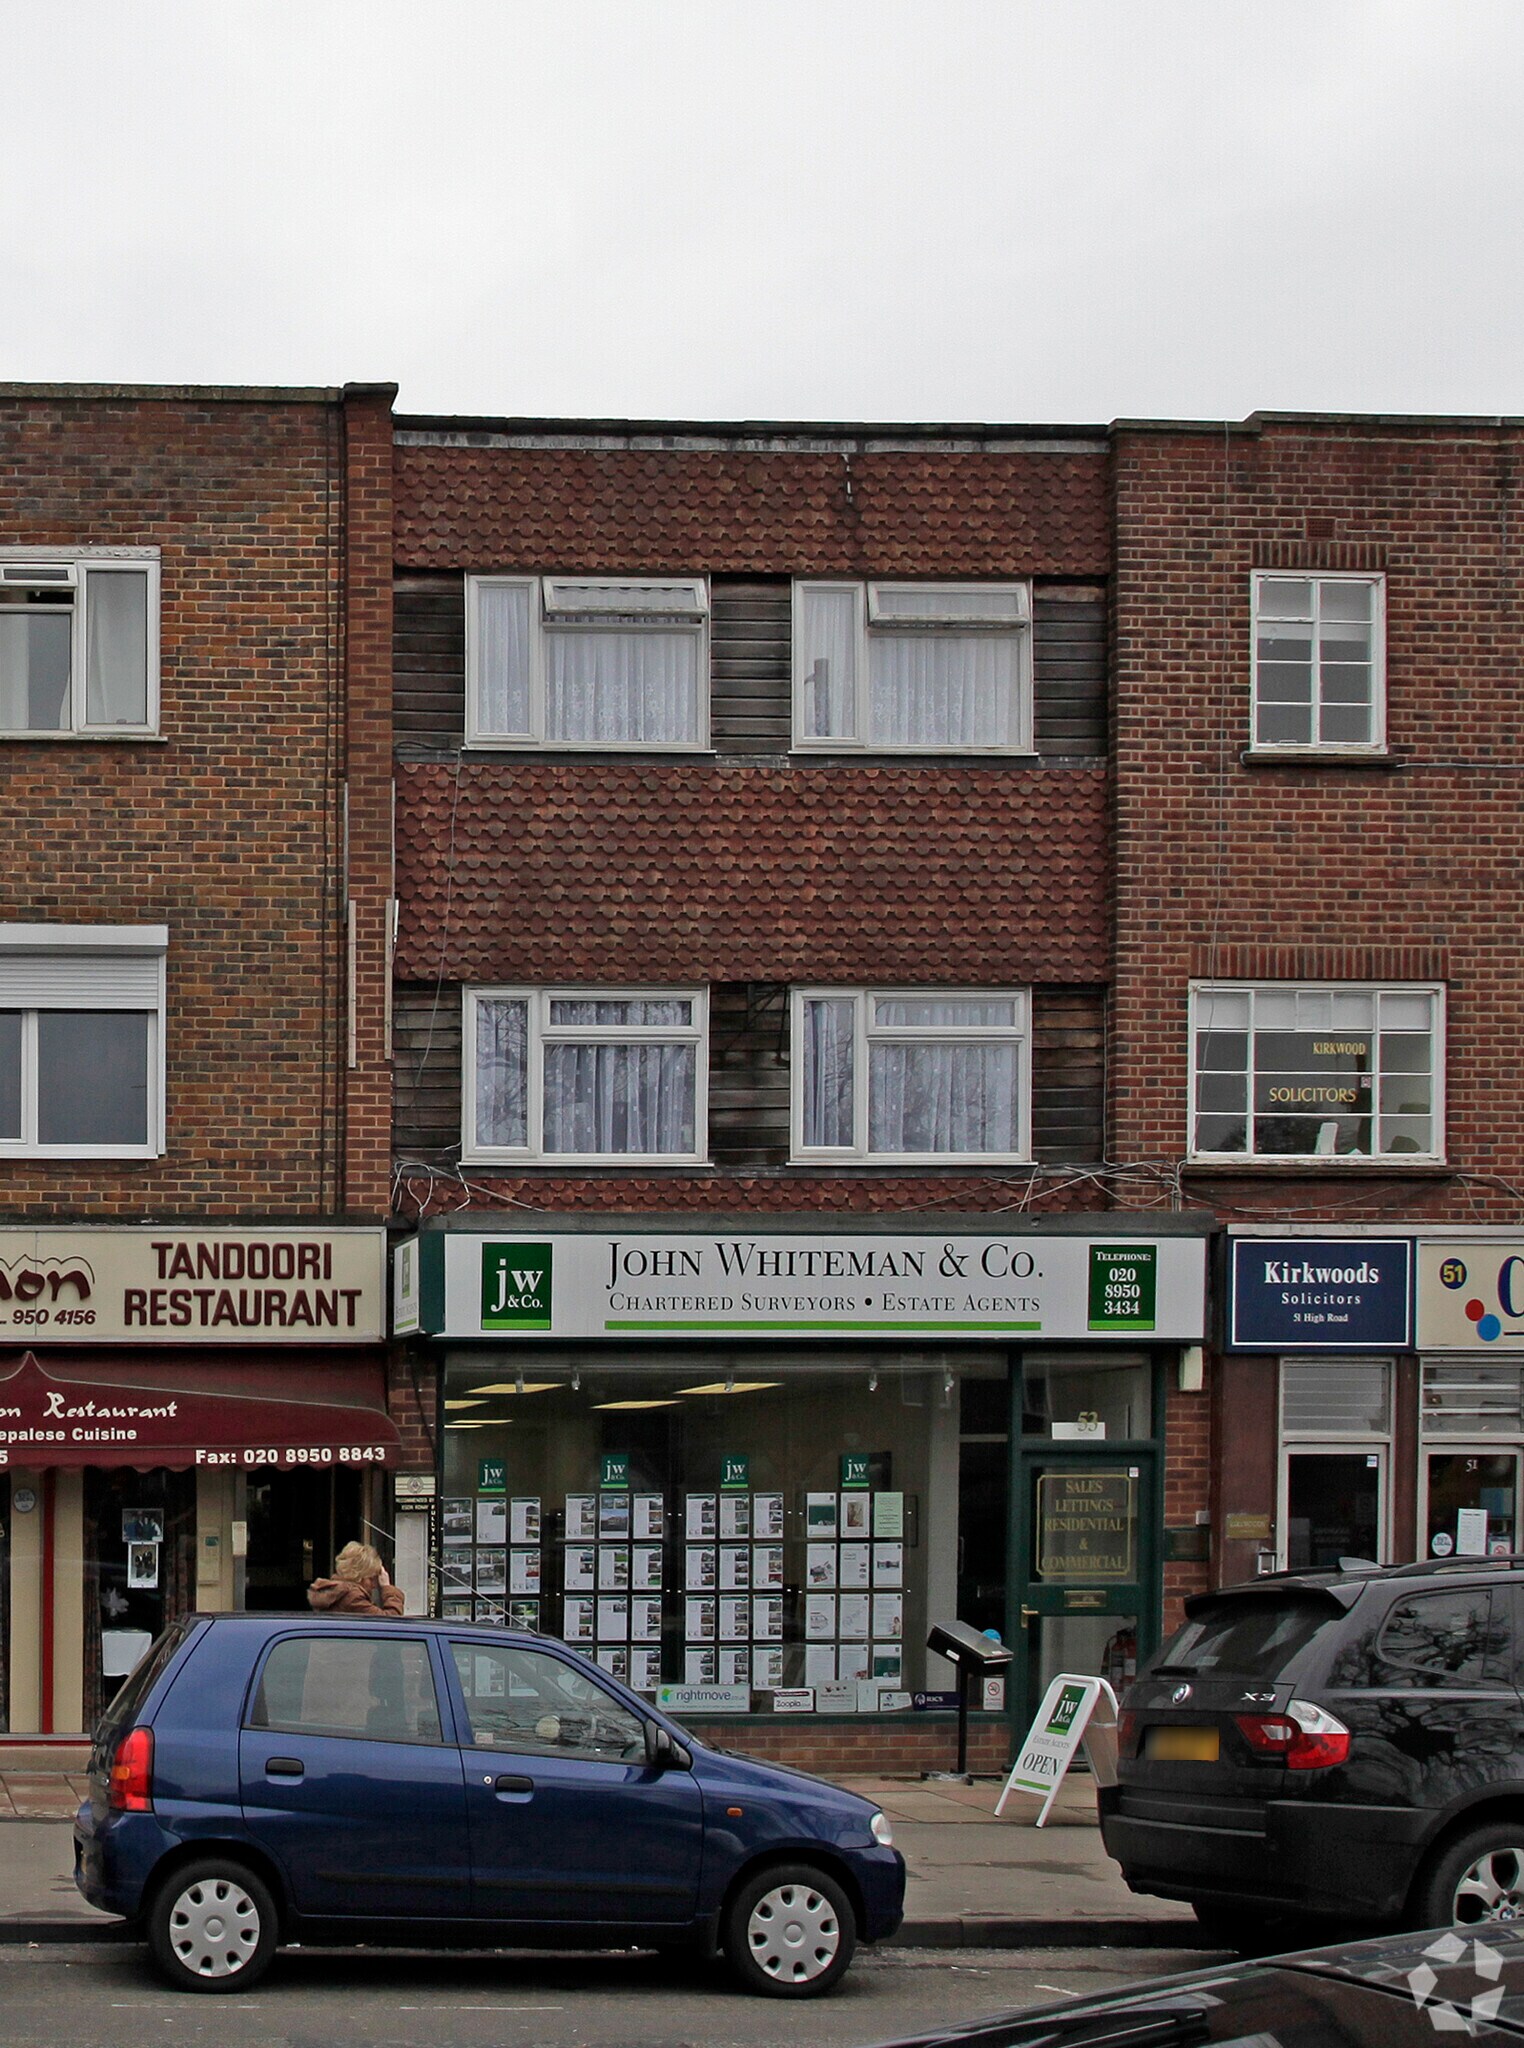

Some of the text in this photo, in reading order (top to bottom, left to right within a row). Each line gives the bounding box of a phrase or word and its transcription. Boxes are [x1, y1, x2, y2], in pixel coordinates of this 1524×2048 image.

[1313, 1042, 1367, 1055] KIRKWOOD
[1269, 1086, 1357, 1103] SOLICITORS
[151, 1242, 332, 1280] TANDOORI
[605, 1242, 704, 1290] JOHN
[714, 1242, 926, 1277] WHITEMAN
[938, 1243, 970, 1278] &
[1108, 1267, 1137, 1282] 020
[1264, 1261, 1379, 1284] Kirkwoods
[1442, 1264, 1464, 1284] 51
[1104, 1283, 1141, 1299] 8950
[1281, 1292, 1362, 1305] Solicitors
[124, 1289, 362, 1327] RESTAURANT
[609, 1292, 1041, 1312] CHARTERED SURVEYORS ESTATE AGENTS
[1103, 1300, 1140, 1315] 3434
[12, 1309, 97, 1325] 950 4156
[1304, 1312, 1325, 1324] High
[1327, 1312, 1349, 1323] Road
[43, 1391, 178, 1419] Restaurant
[1077, 1411, 1098, 1432] 53
[0, 1426, 138, 1444] epalese Cuisine
[195, 1449, 237, 1464] Fax:
[244, 1448, 279, 1464] 020
[285, 1447, 333, 1463] 8950
[339, 1447, 386, 1462] 8843
[1465, 1459, 1478, 1473] 51
[1065, 1480, 1104, 1494] SALES
[1055, 1499, 1114, 1513] LETTINGS
[1045, 1517, 1124, 1531] RESIDENTIAL
[1078, 1536, 1089, 1550] &
[1041, 1555, 1126, 1569] COMMERCIAL
[1240, 1692, 1276, 1702] X3
[1022, 1752, 1064, 1776] OPEN
